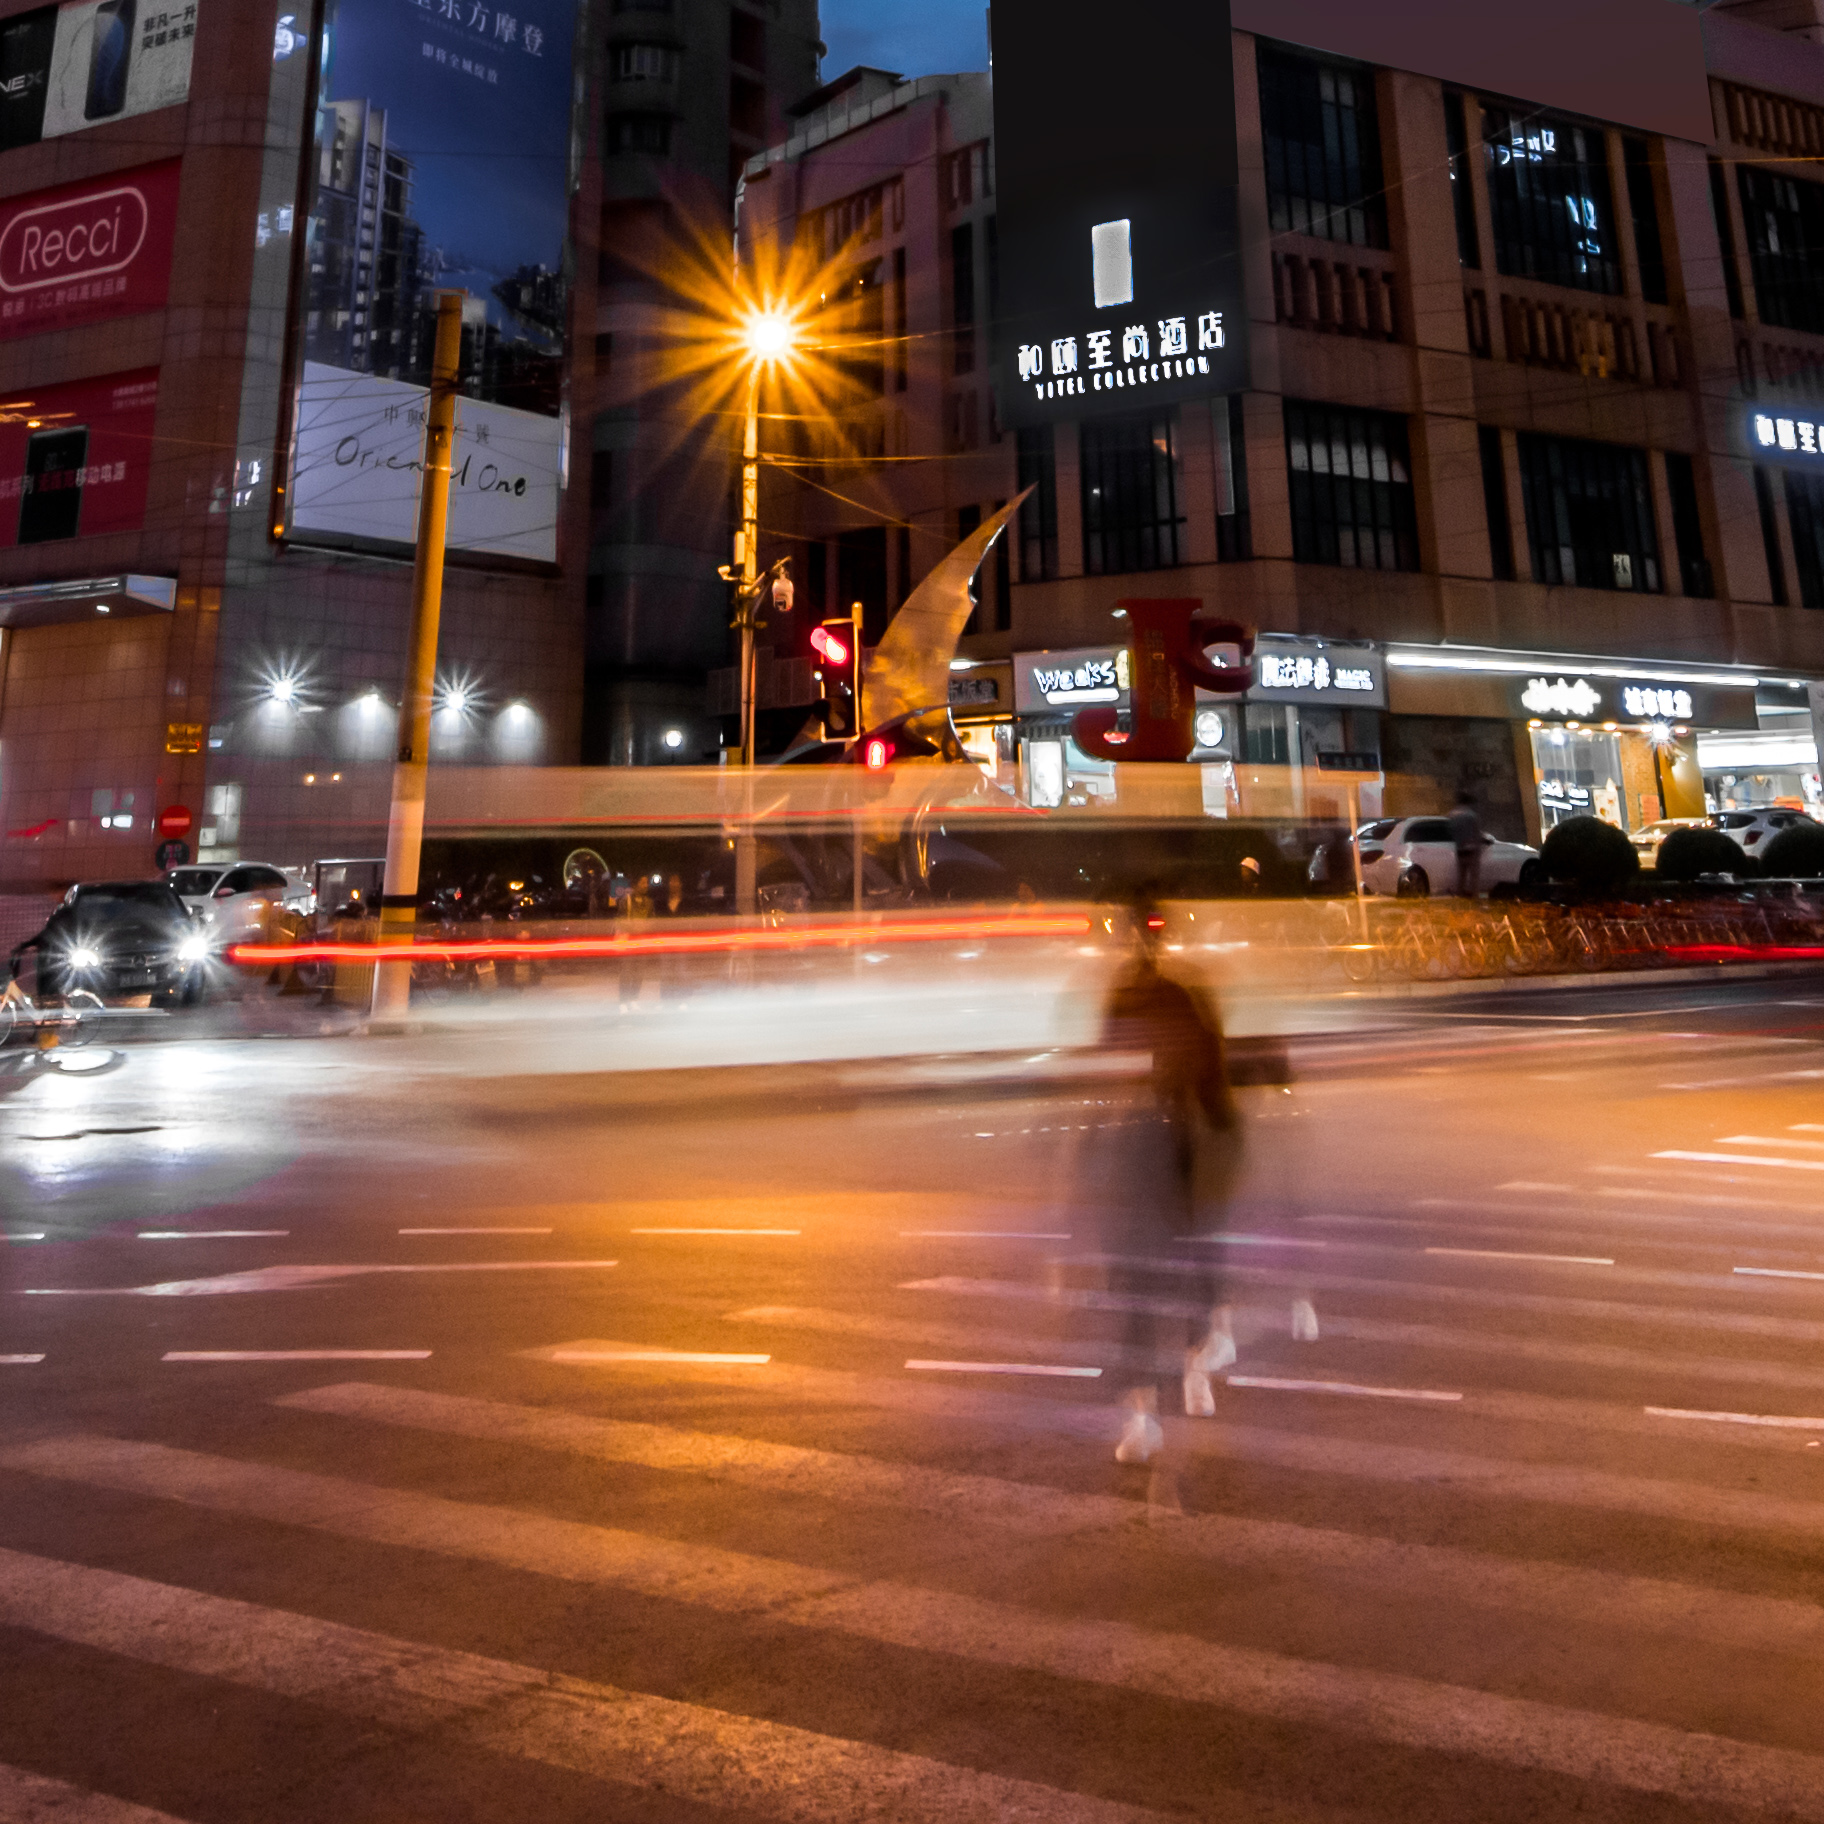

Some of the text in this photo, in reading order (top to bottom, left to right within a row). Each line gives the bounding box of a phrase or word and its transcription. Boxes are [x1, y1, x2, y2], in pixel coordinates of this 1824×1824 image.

[20, 206, 122, 275] Recci
[1017, 310, 1226, 382] 和颐至尚酒店
[1093, 355, 1210, 391] COLLECTION
[479, 464, 527, 497] One
